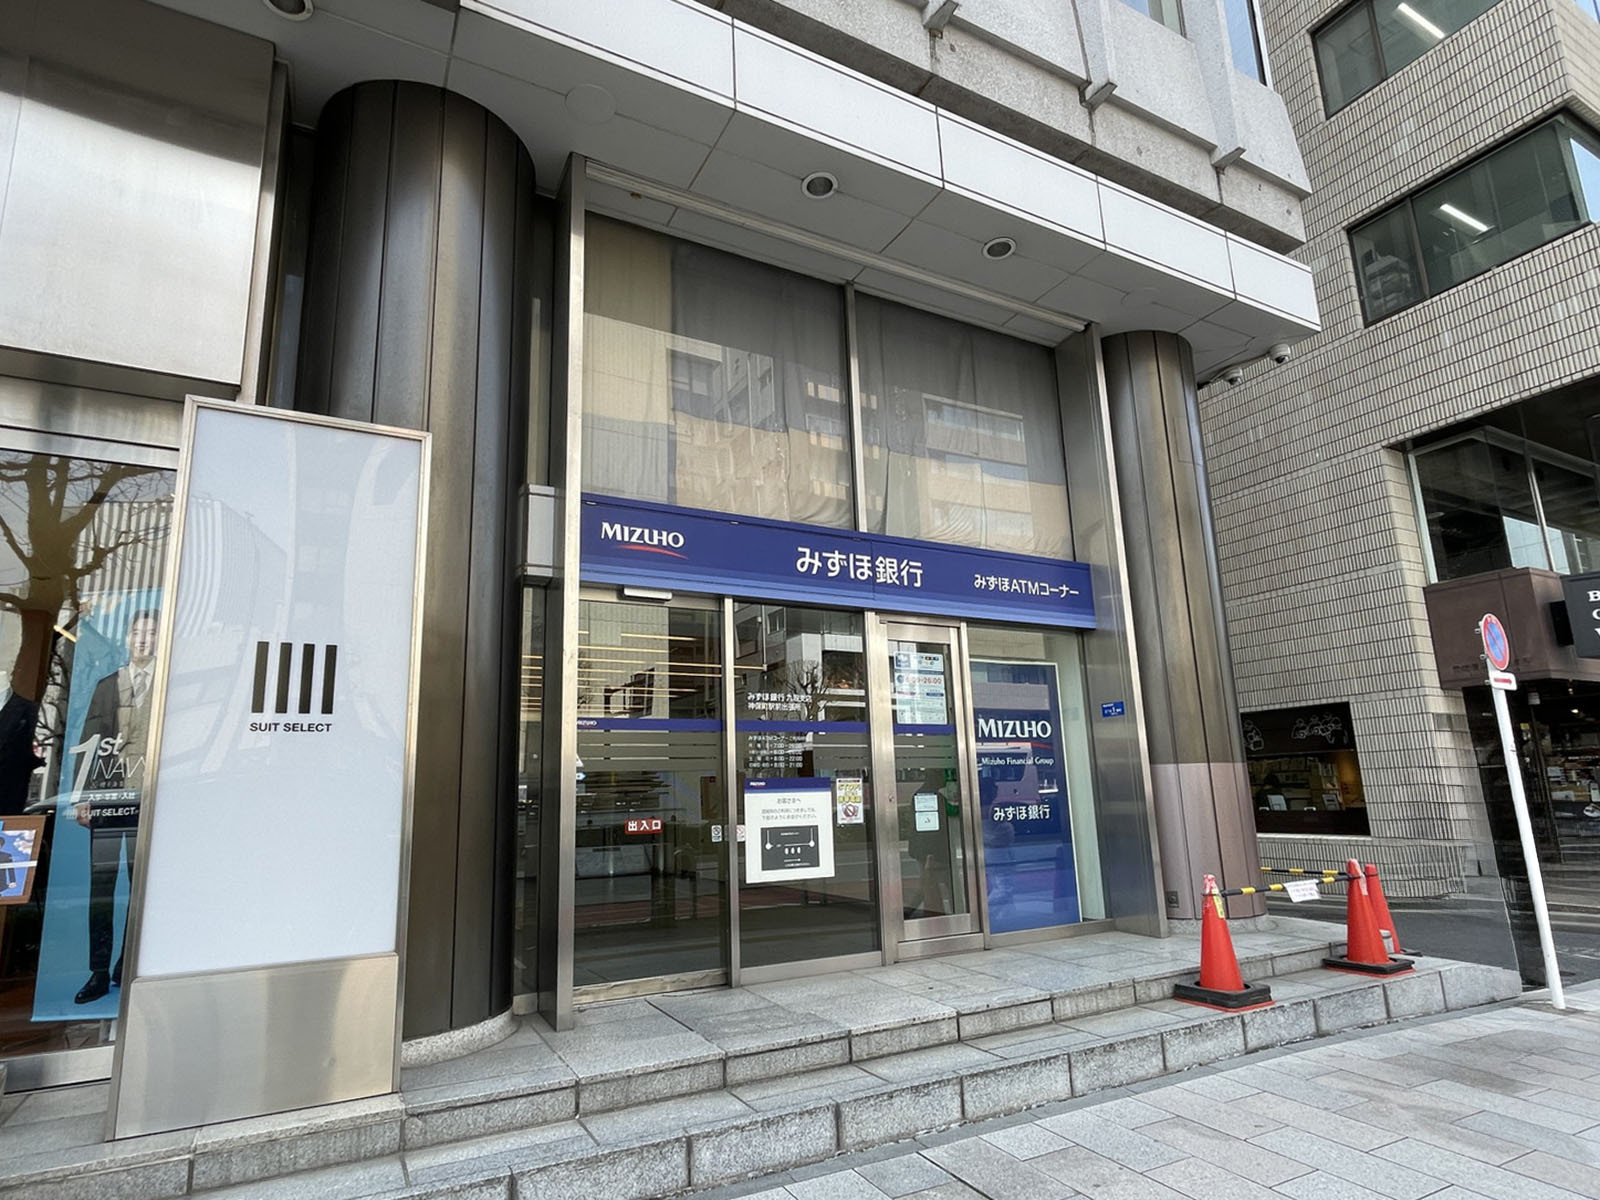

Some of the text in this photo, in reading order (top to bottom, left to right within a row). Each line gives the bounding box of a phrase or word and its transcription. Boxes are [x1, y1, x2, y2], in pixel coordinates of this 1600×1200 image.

[600, 521, 685, 548] MIZUHO
[796, 547, 923, 587] みずほ銀行
[974, 574, 1080, 598] みずほATMコーナー
[249, 722, 333, 733] SUIT SELECT
[978, 718, 1052, 738] MIZUHO
[981, 757, 1054, 766] Mizuho Financial Group
[102, 807, 136, 817] SELECT
[993, 804, 1050, 821] みずほ銀行
[627, 820, 661, 832] 出入口
